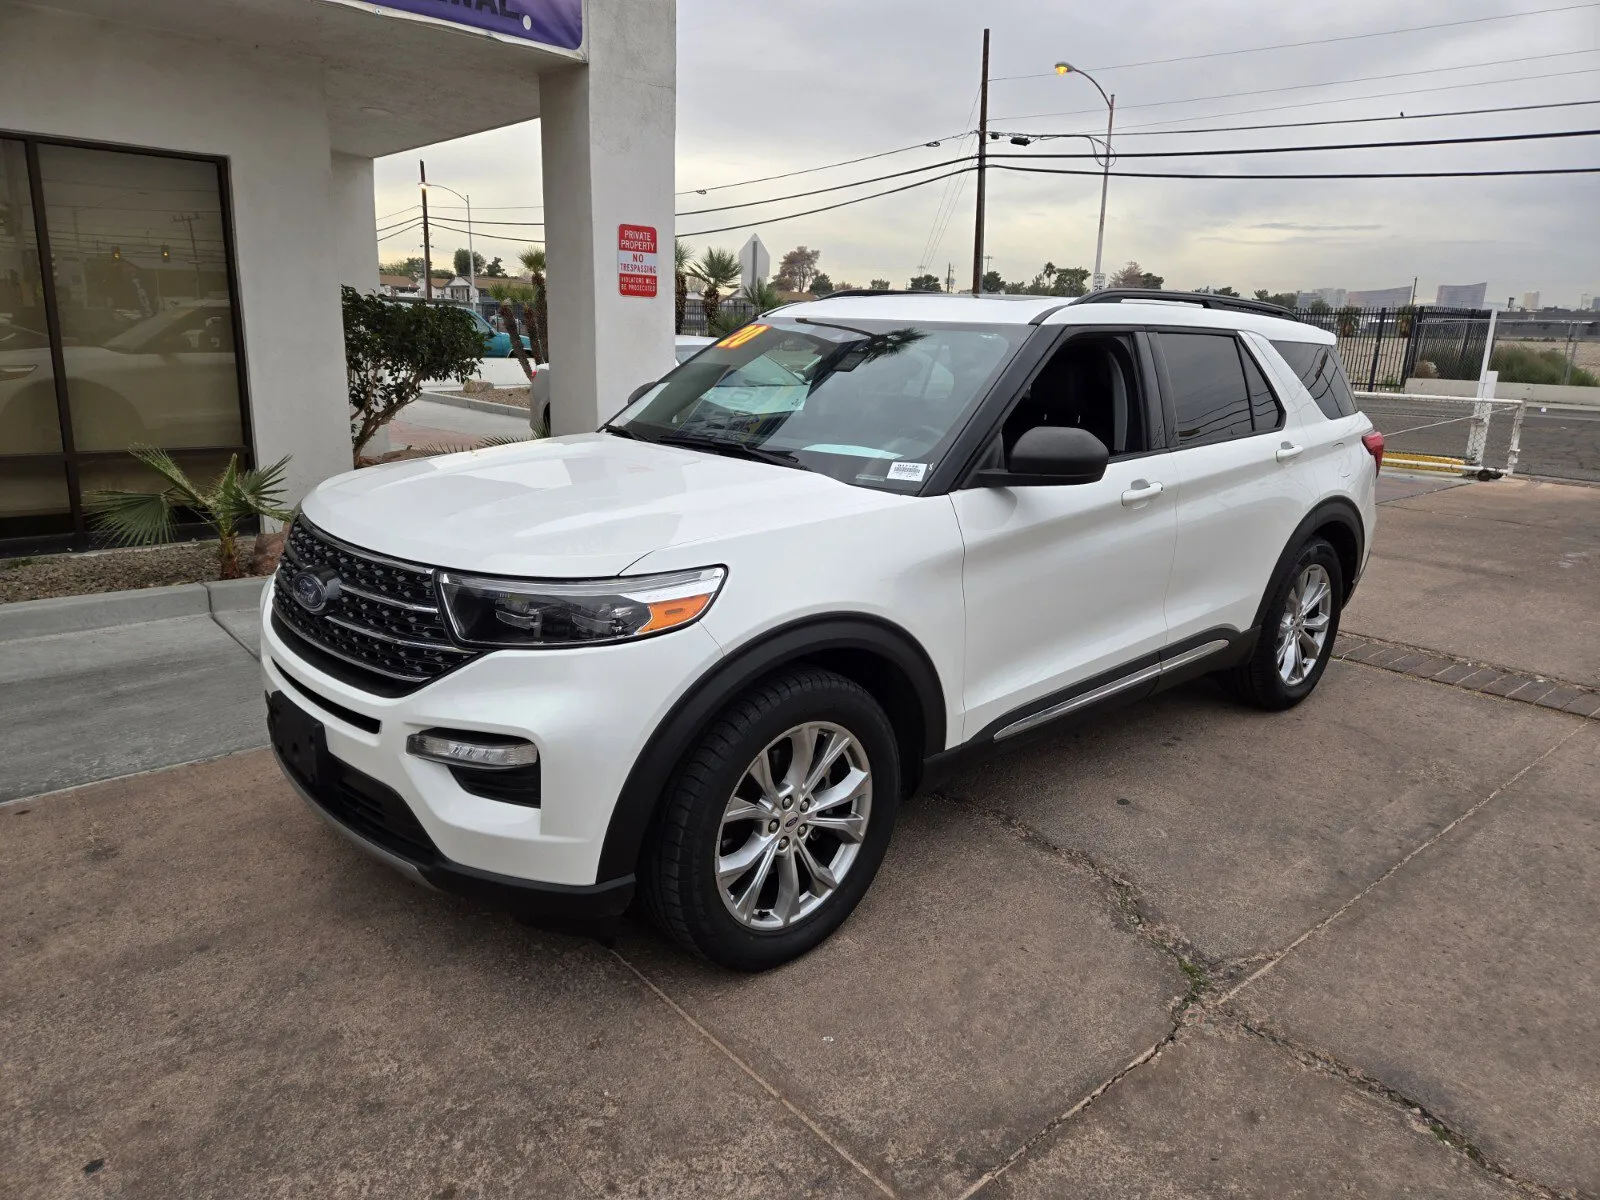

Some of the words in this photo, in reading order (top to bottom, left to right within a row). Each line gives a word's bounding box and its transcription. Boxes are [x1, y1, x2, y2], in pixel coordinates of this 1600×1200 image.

[624, 229, 651, 241] PRIVATE
[620, 239, 655, 251] PROPERTY
[632, 254, 644, 263] NO
[620, 263, 656, 274] TRESPASSING
